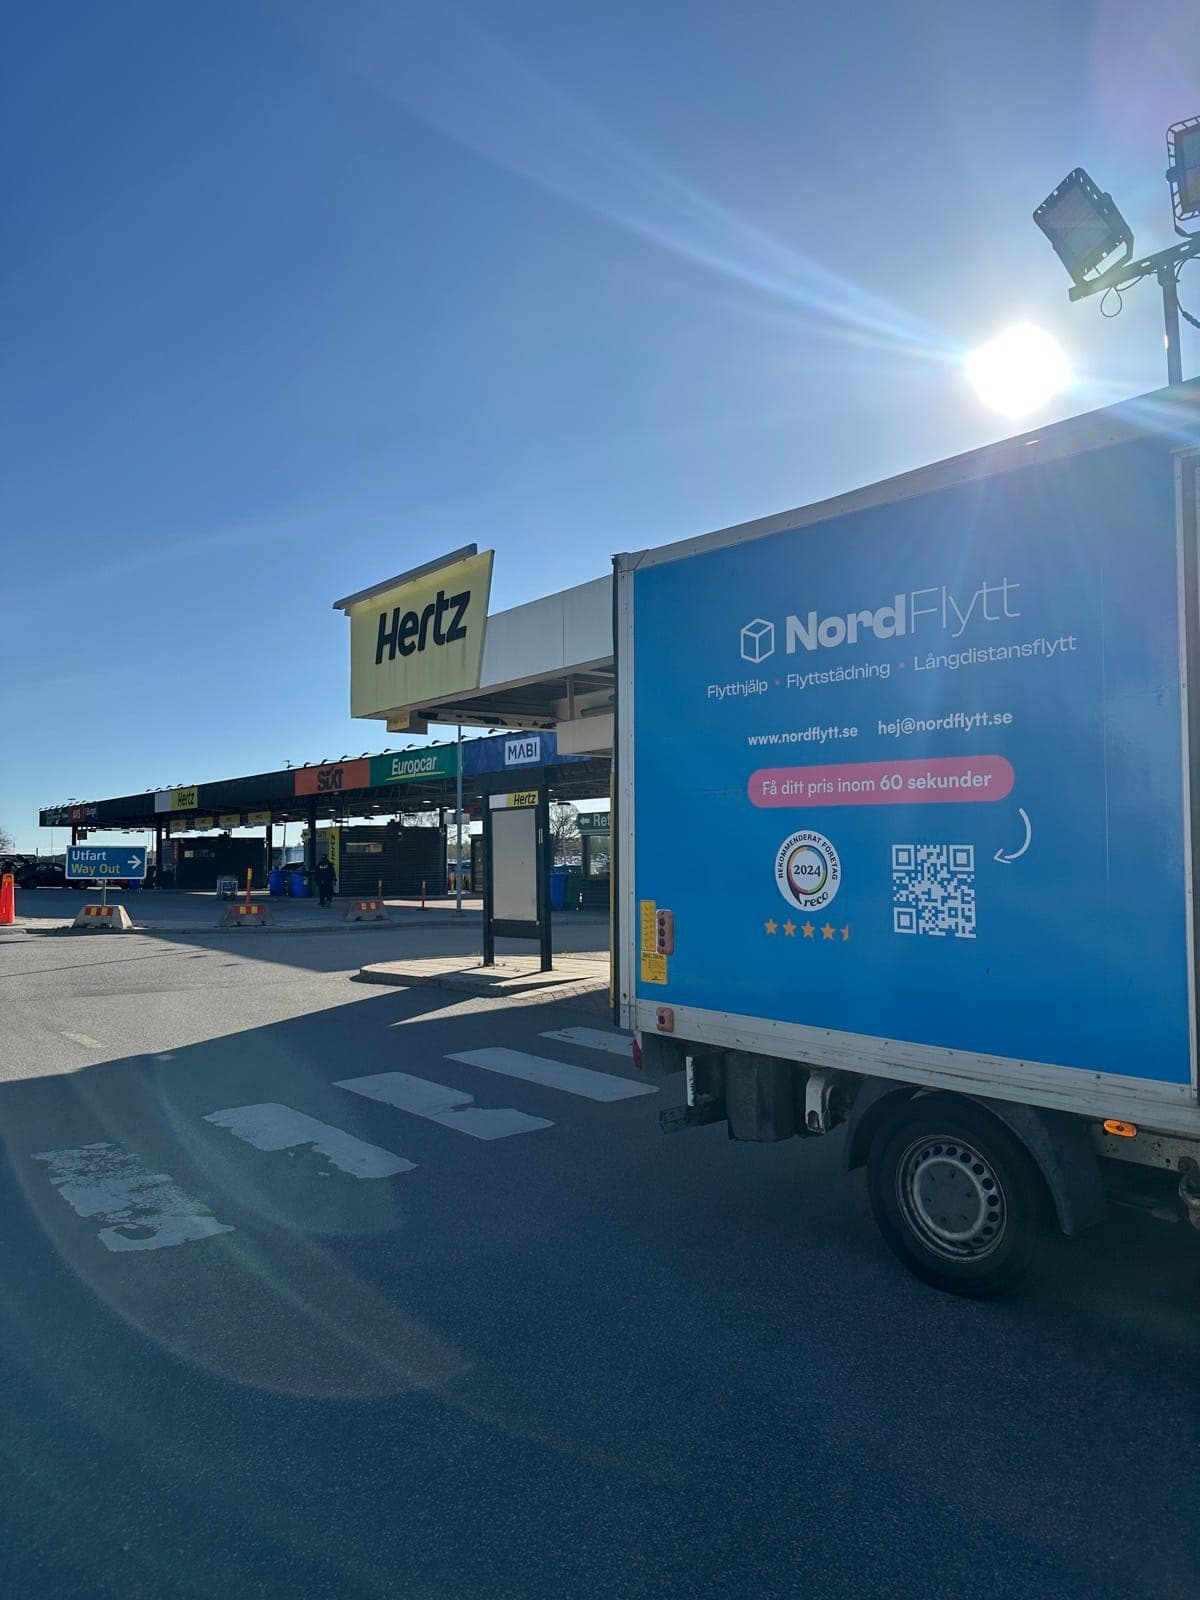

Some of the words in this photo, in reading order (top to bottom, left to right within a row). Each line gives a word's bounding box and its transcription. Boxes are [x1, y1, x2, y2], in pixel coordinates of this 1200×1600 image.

[785, 577, 1021, 655] NordFlytt
[375, 590, 471, 665] Hertz
[706, 678, 769, 700] Flytthjälp
[786, 661, 891, 690] Flyttstädning
[913, 634, 1078, 672] Långdistansflytt
[747, 724, 859, 747] www.nordflytt.se
[877, 711, 1014, 737] hej@nordflytt.se
[507, 741, 538, 762] MABI
[391, 756, 438, 777] Europcar
[761, 780, 778, 796] Få
[780, 779, 805, 796] ditt
[807, 778, 835, 798] pris
[837, 777, 876, 794] inom
[879, 774, 903, 791] 60
[907, 771, 992, 790] sekunder
[177, 792, 195, 807] Hertz
[513, 793, 537, 806] Hertz
[71, 849, 107, 861] Utfart
[777, 833, 822, 879] REKOMMENDERAT
[821, 841, 838, 881] FÖRETAG
[71, 863, 96, 876] Way
[99, 863, 121, 874] Out
[793, 864, 821, 878] 2024
